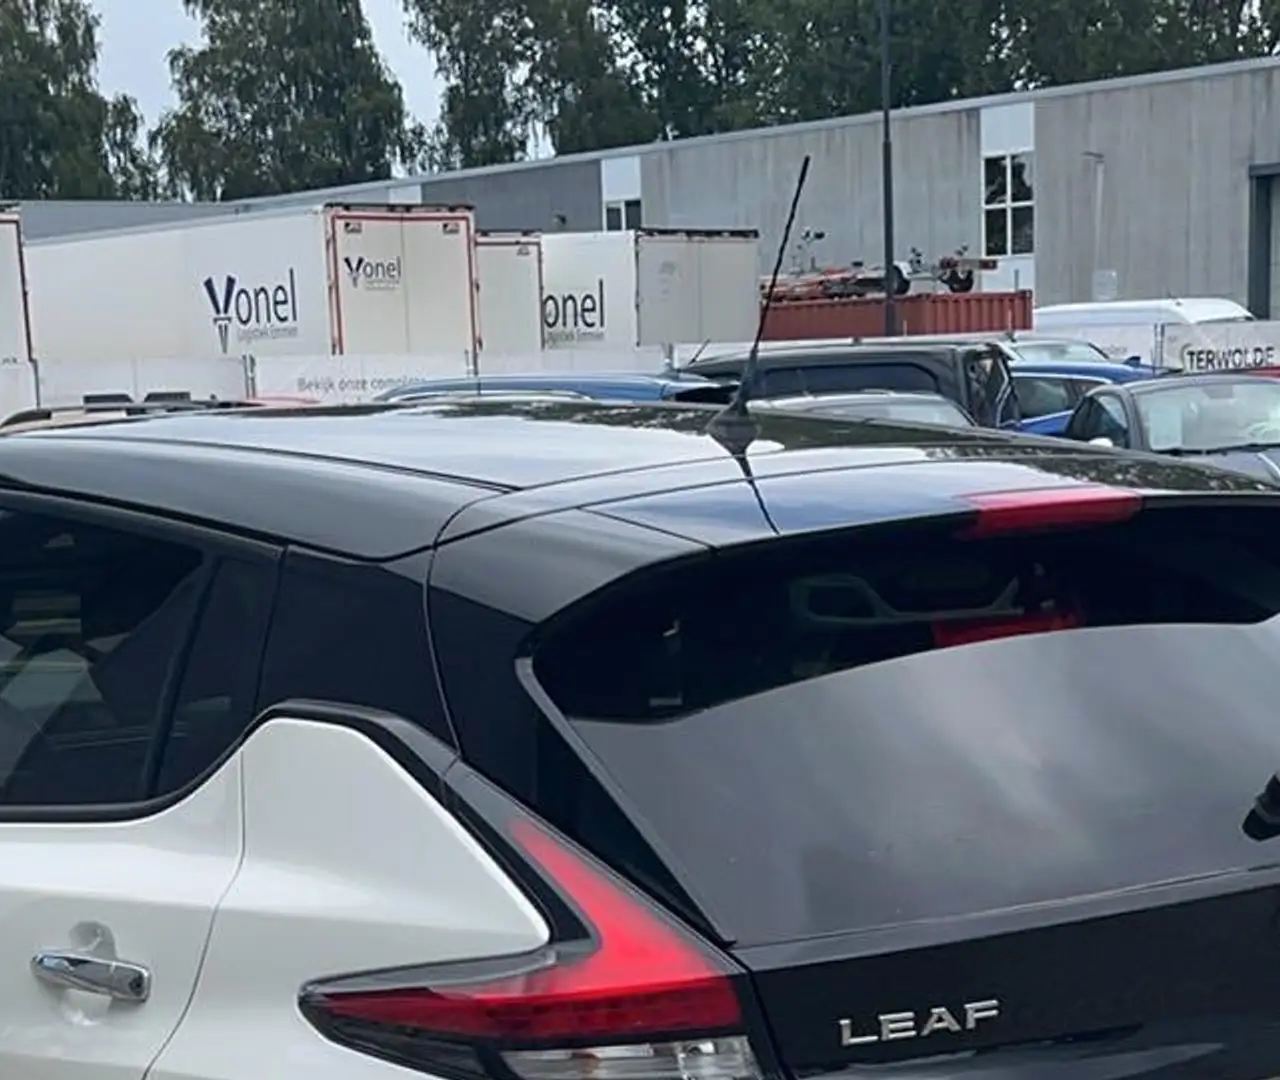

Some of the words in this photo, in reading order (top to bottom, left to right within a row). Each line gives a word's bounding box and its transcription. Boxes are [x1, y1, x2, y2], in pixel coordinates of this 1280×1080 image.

[343, 255, 401, 288] Vonel
[203, 266, 298, 353] Vonel
[542, 278, 606, 328] onel
[838, 999, 1000, 1046] LEAF
